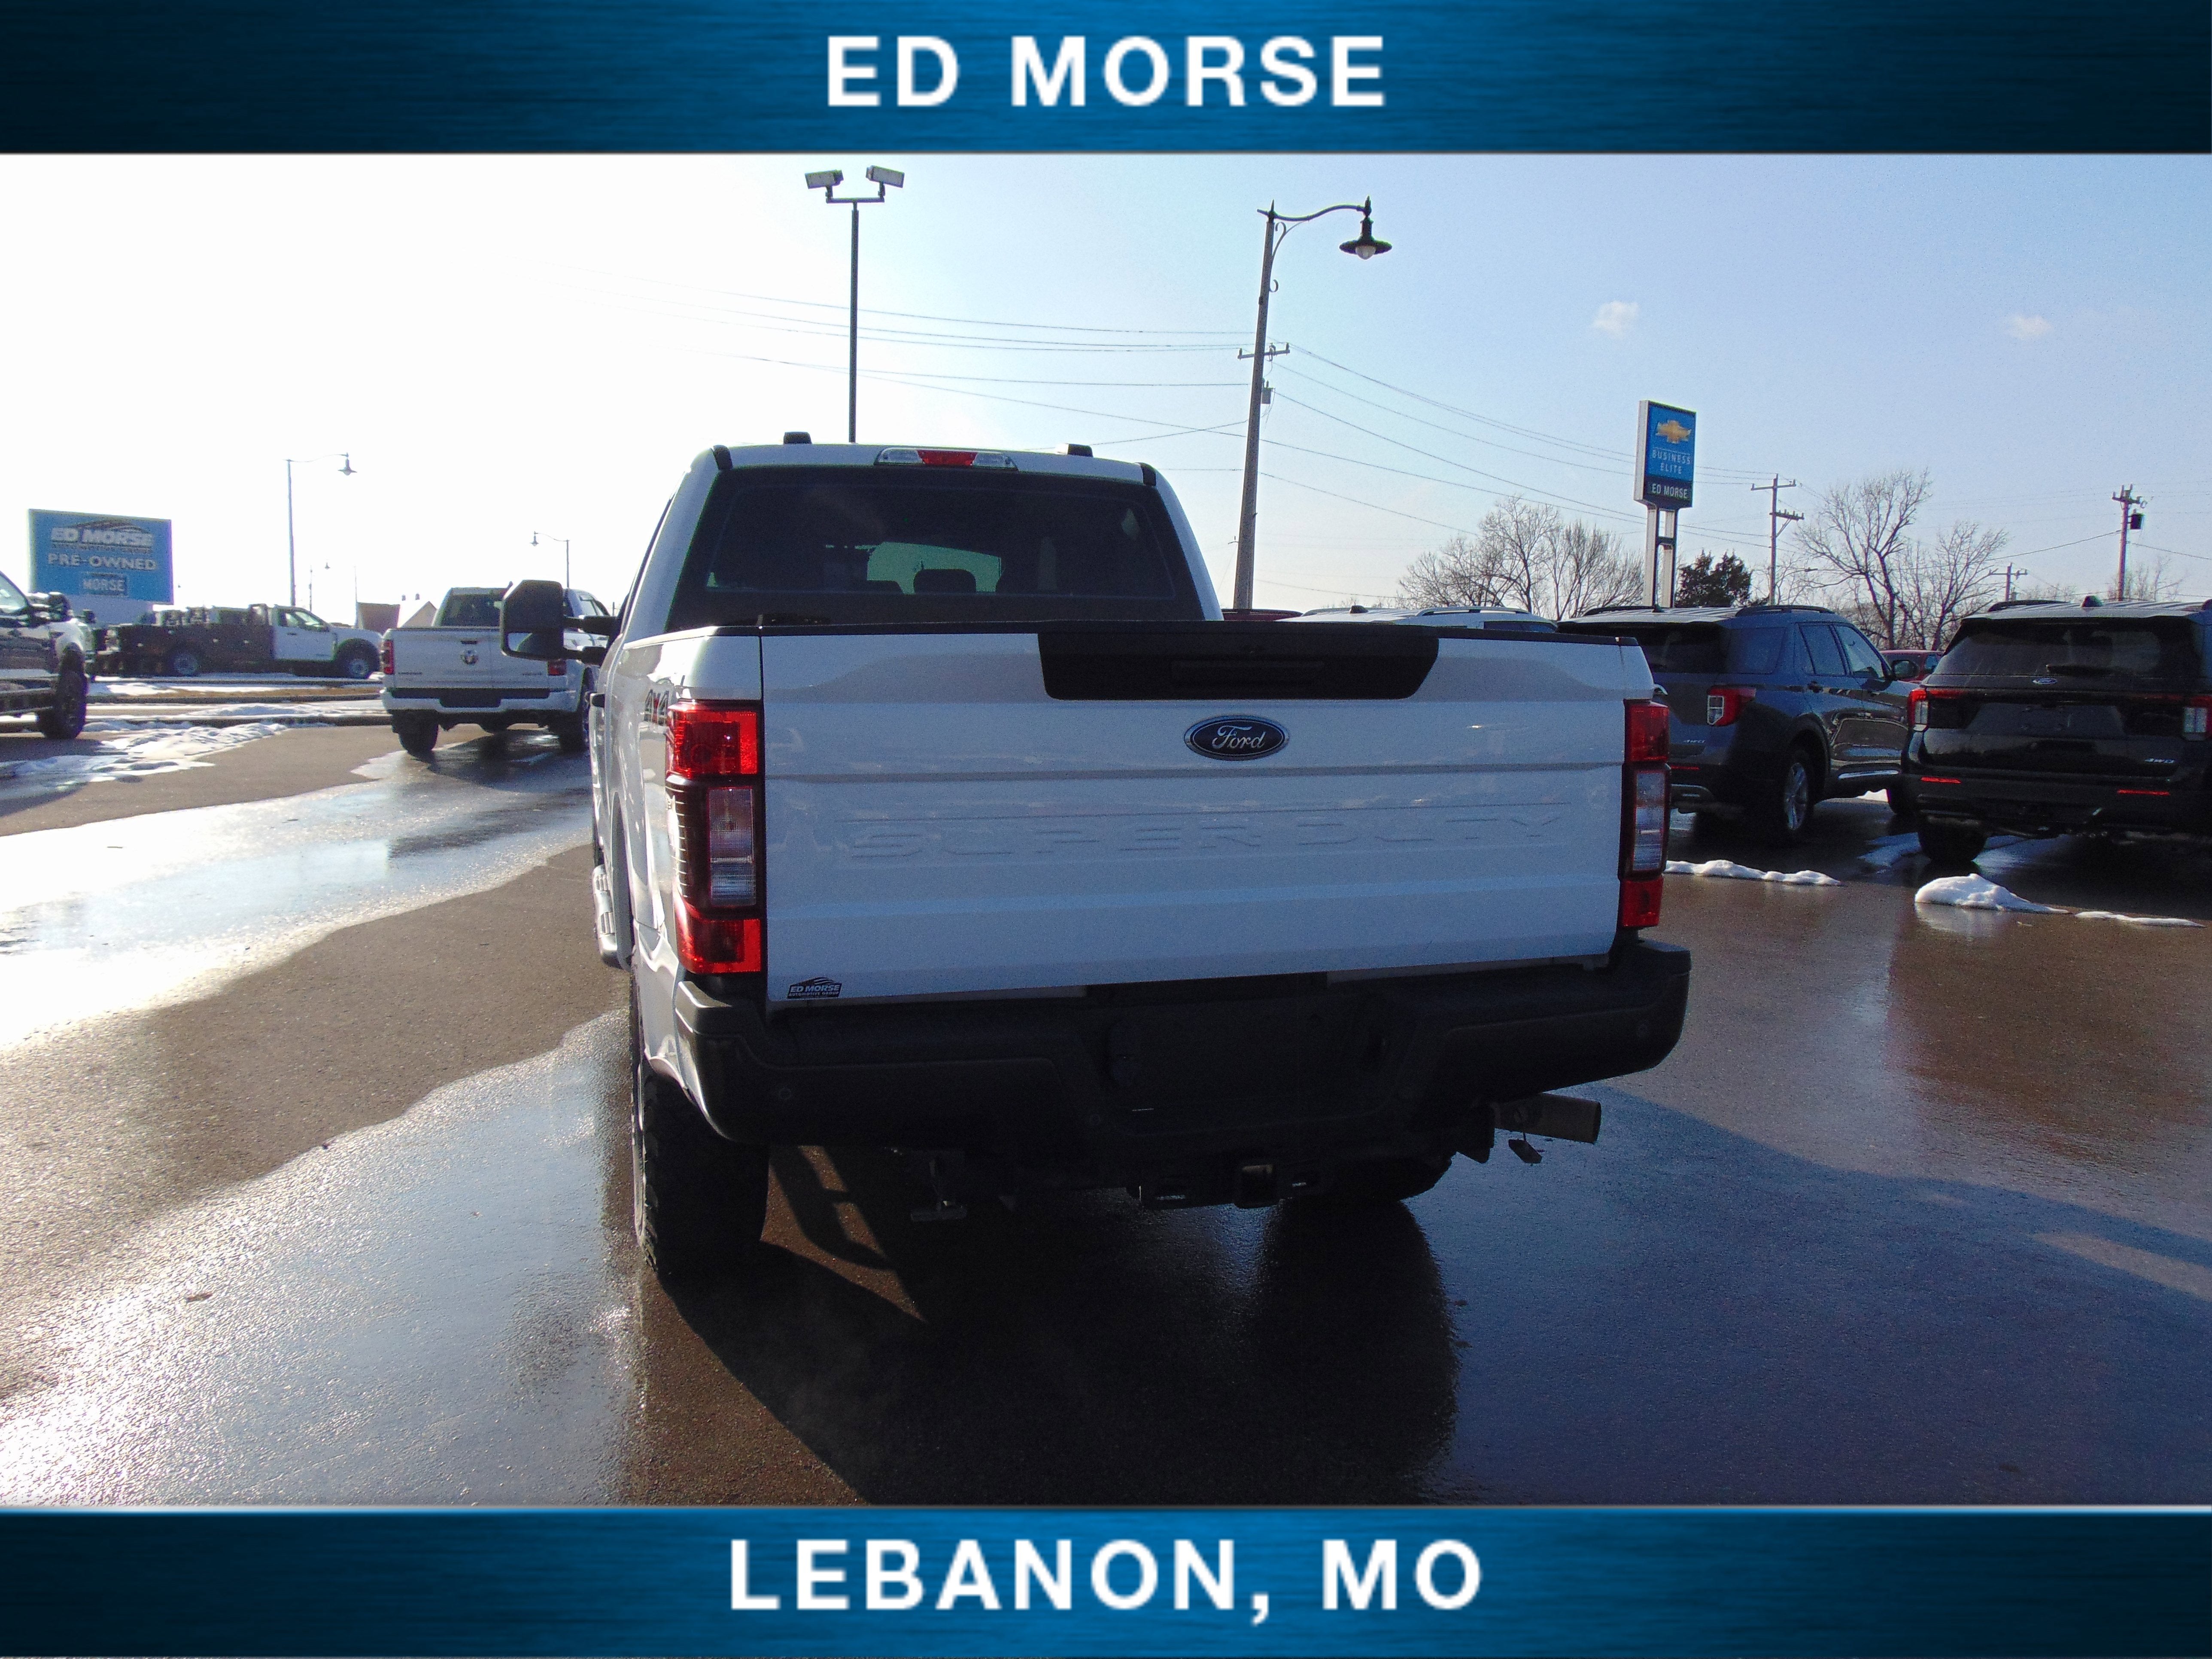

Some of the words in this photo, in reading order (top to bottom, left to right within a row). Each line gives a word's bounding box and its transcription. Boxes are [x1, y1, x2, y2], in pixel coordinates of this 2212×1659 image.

[1653, 449, 1690, 465] BUSINESS
[1660, 462, 1682, 474] ELITE
[1652, 483, 1661, 494] ED
[1664, 486, 1687, 498] MORSE
[51, 527, 79, 542] ED
[82, 529, 153, 548] MORSE
[48, 553, 157, 570] PRE-OWNED
[83, 578, 125, 592] MORSE
[1212, 725, 1266, 748] Ford
